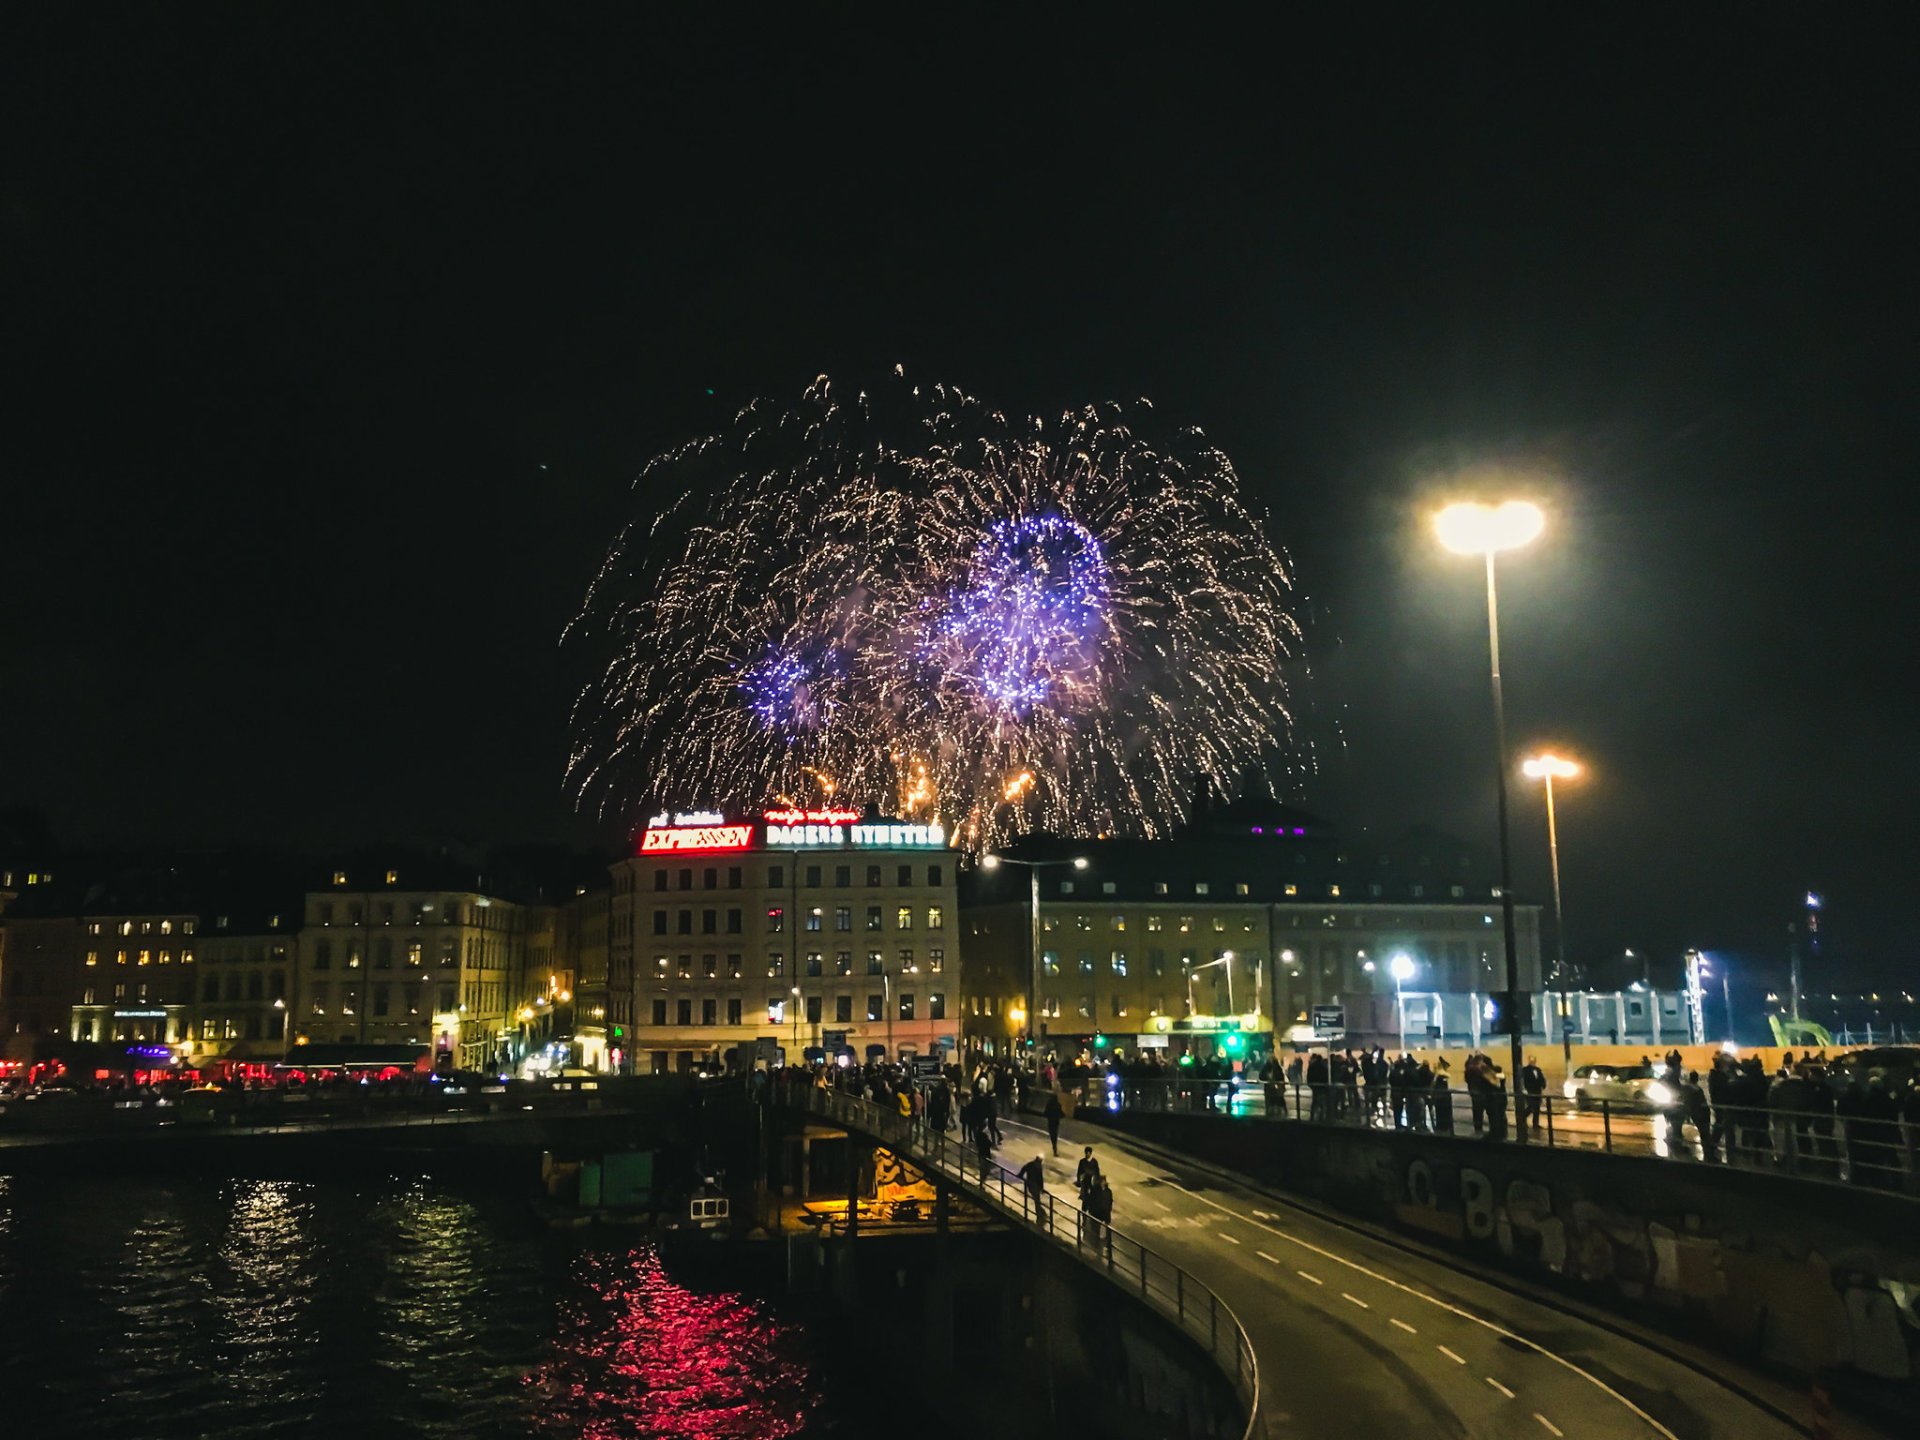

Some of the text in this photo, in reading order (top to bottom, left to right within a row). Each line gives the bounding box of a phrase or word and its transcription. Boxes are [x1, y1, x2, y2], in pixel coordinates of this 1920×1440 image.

[641, 826, 752, 850] EXPRESSEN
[767, 825, 944, 844] DAGENS NYHETER
